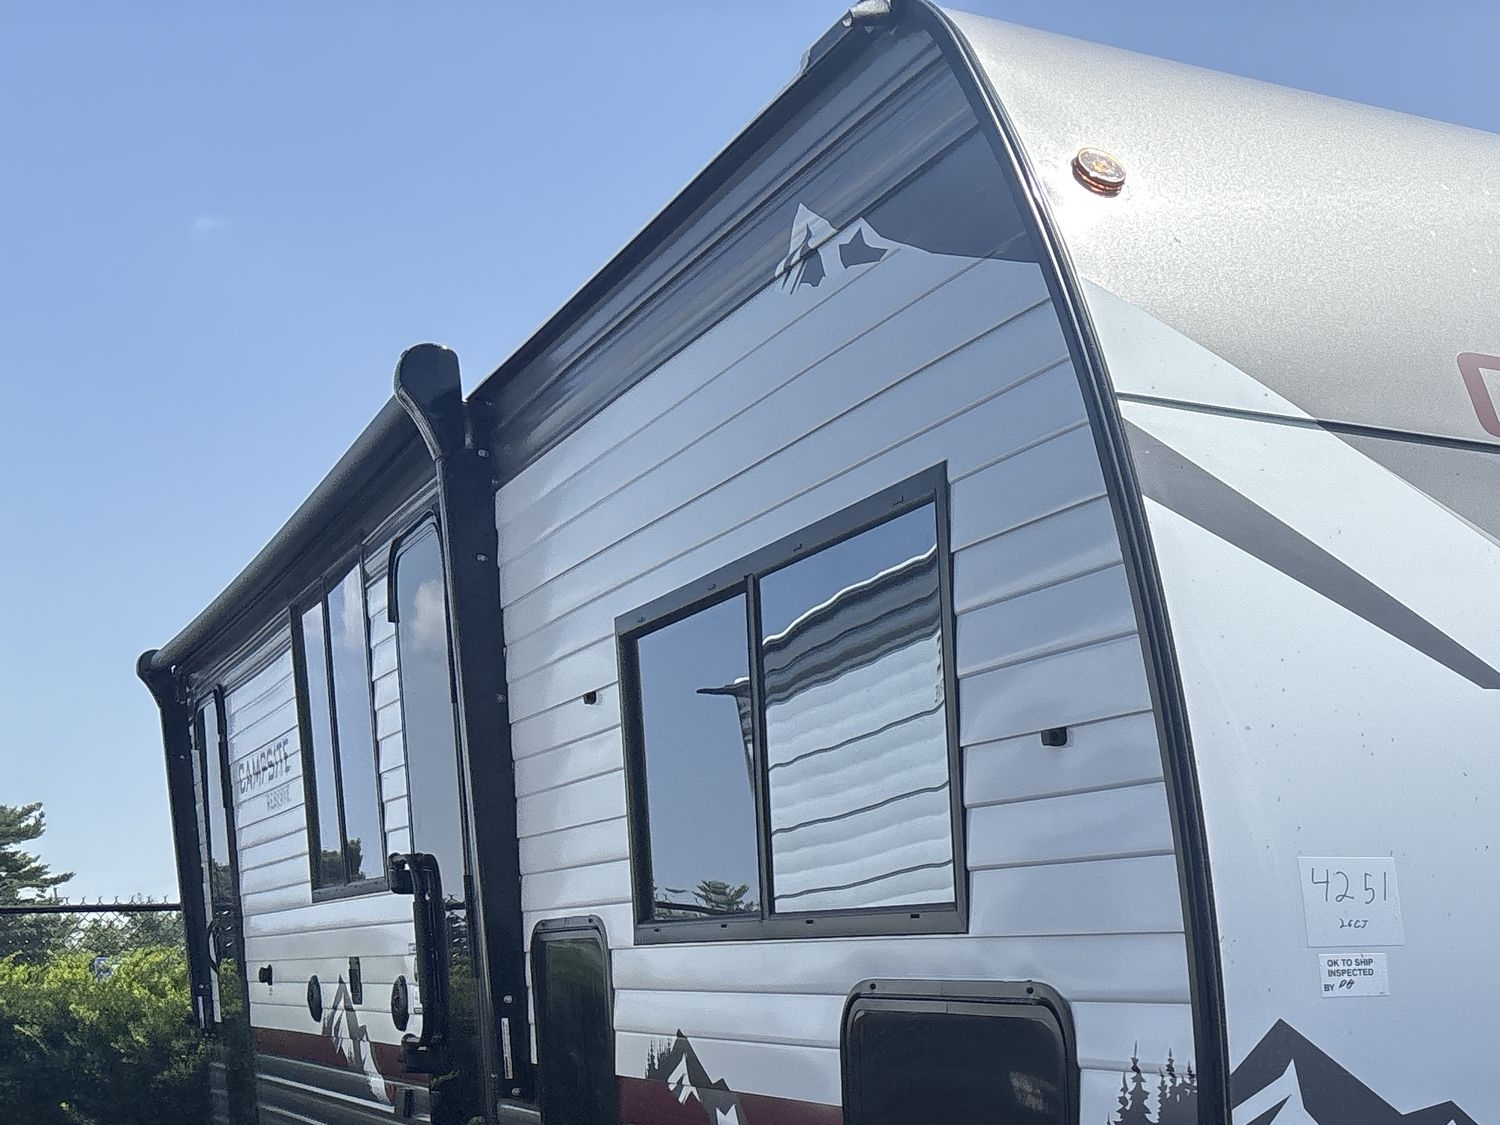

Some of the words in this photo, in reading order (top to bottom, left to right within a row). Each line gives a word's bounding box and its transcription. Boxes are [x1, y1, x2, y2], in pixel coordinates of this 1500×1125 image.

[238, 738, 291, 794] CAMPSITE
[1311, 867, 1387, 905] 4251
[1327, 959, 1340, 967] OK
[1341, 959, 1353, 967] TO
[1354, 958, 1374, 967] SHIP
[1327, 968, 1374, 977] INSPECTED
[1323, 984, 1335, 992] BY
